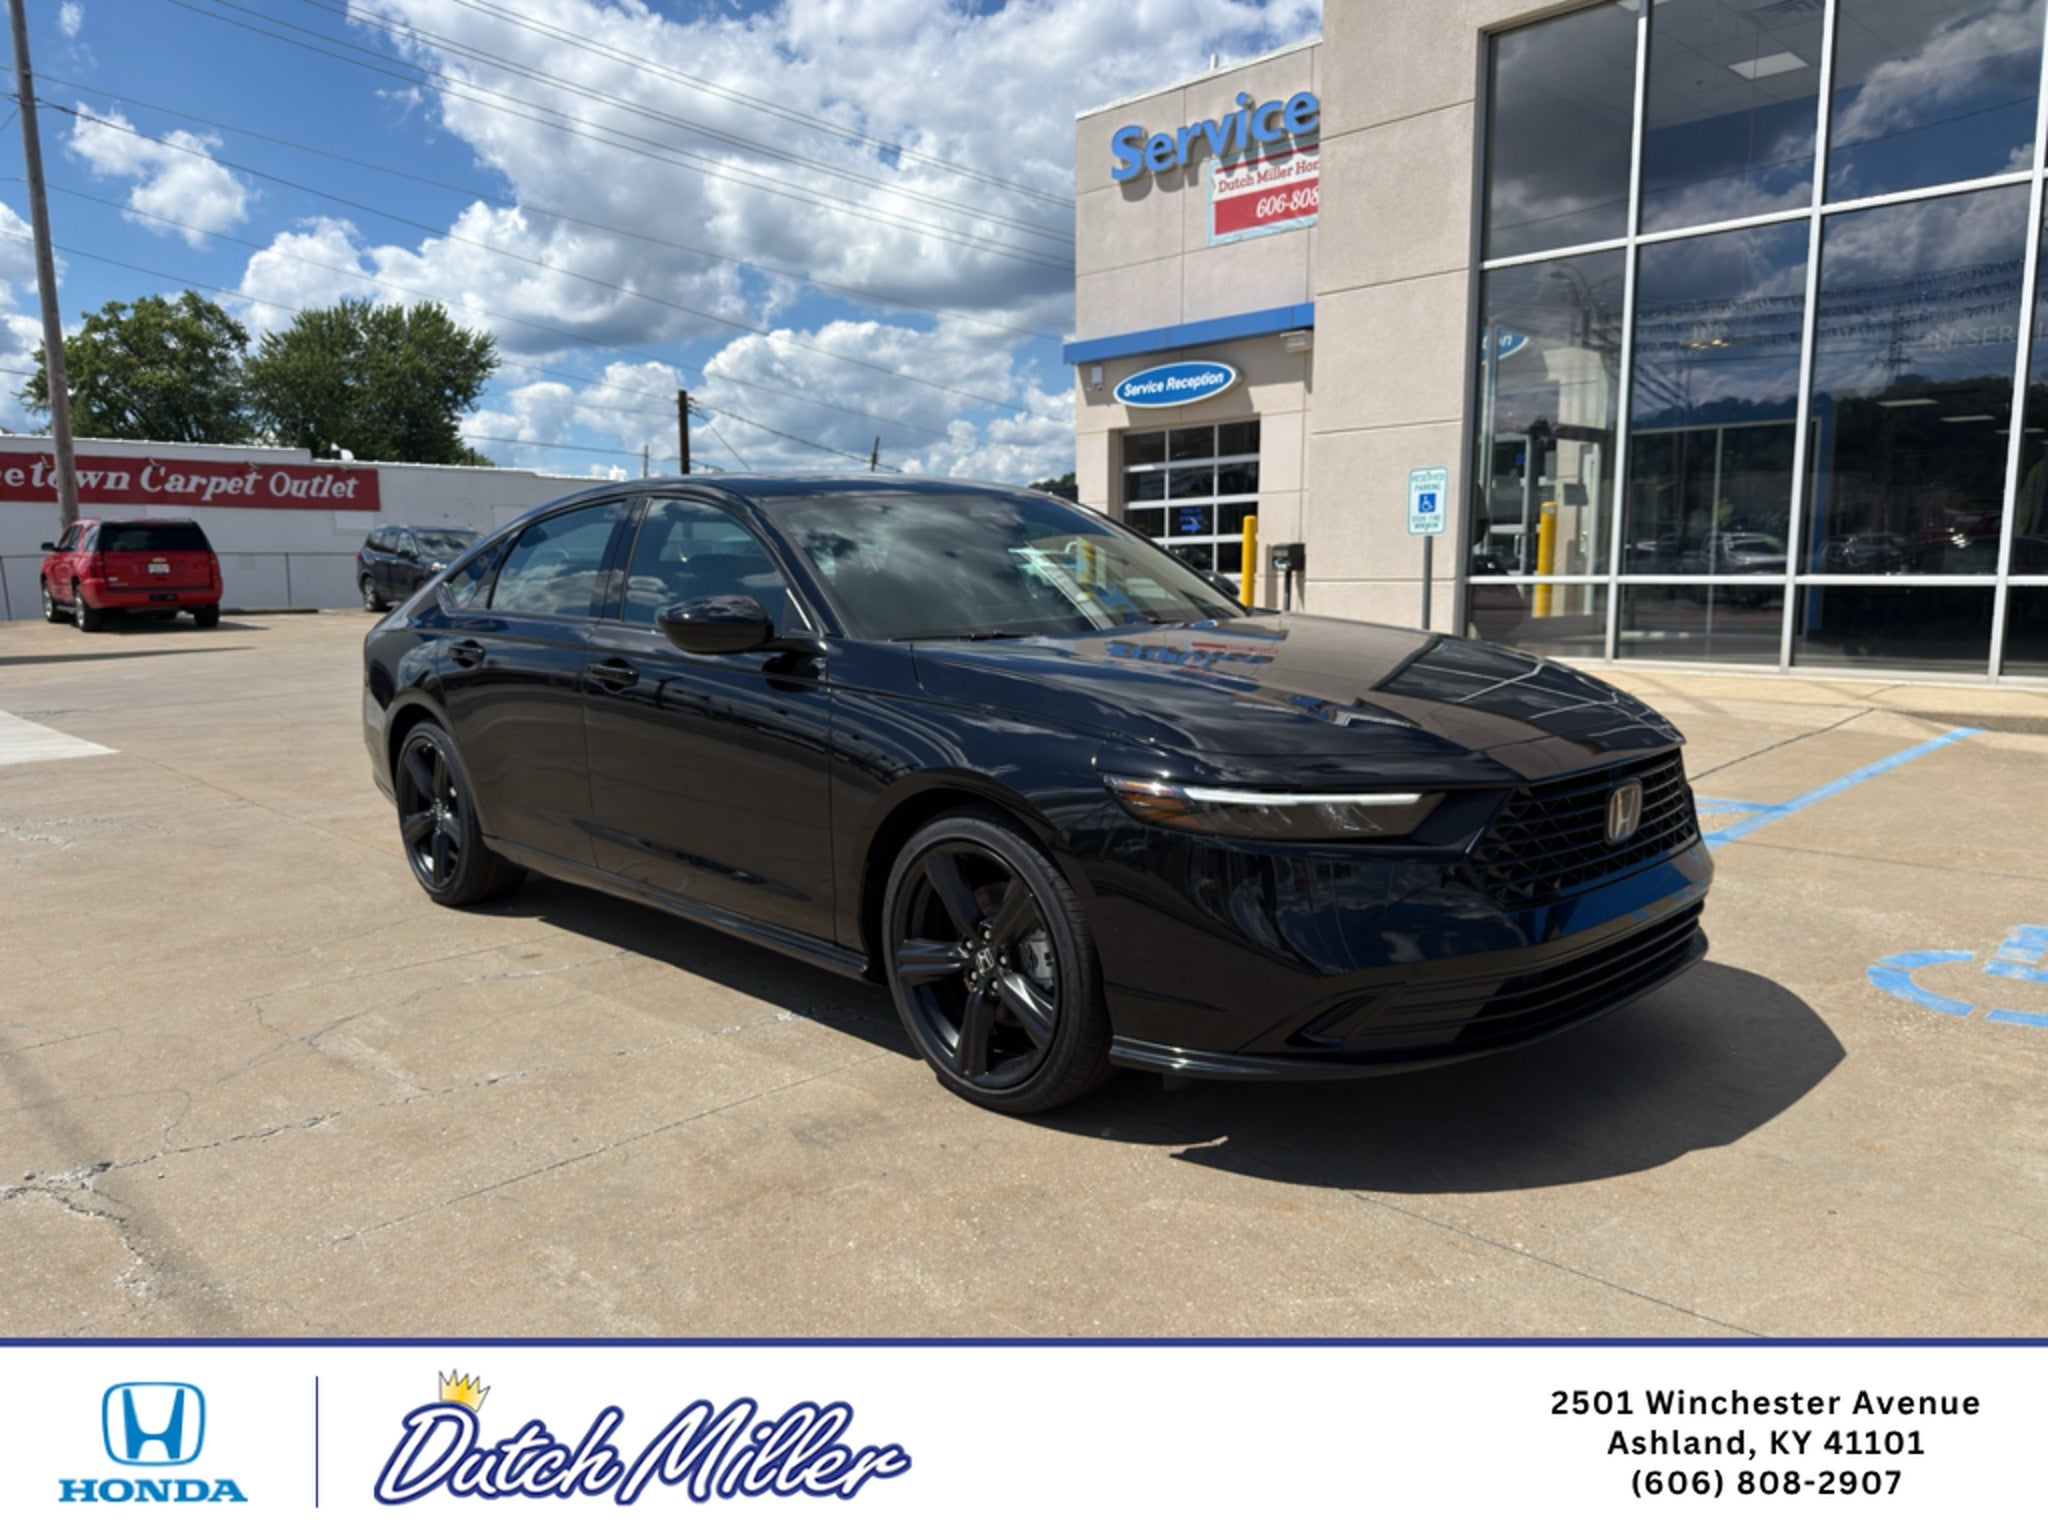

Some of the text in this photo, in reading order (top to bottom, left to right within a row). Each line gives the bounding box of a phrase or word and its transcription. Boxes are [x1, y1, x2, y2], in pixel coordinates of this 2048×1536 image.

[1111, 91, 1318, 181] Service
[1218, 174, 1254, 193] Dutch
[1256, 165, 1293, 184] Miller
[1124, 372, 1224, 397] Service Reception
[140, 464, 262, 500] Carpet
[269, 471, 358, 499] Outlet
